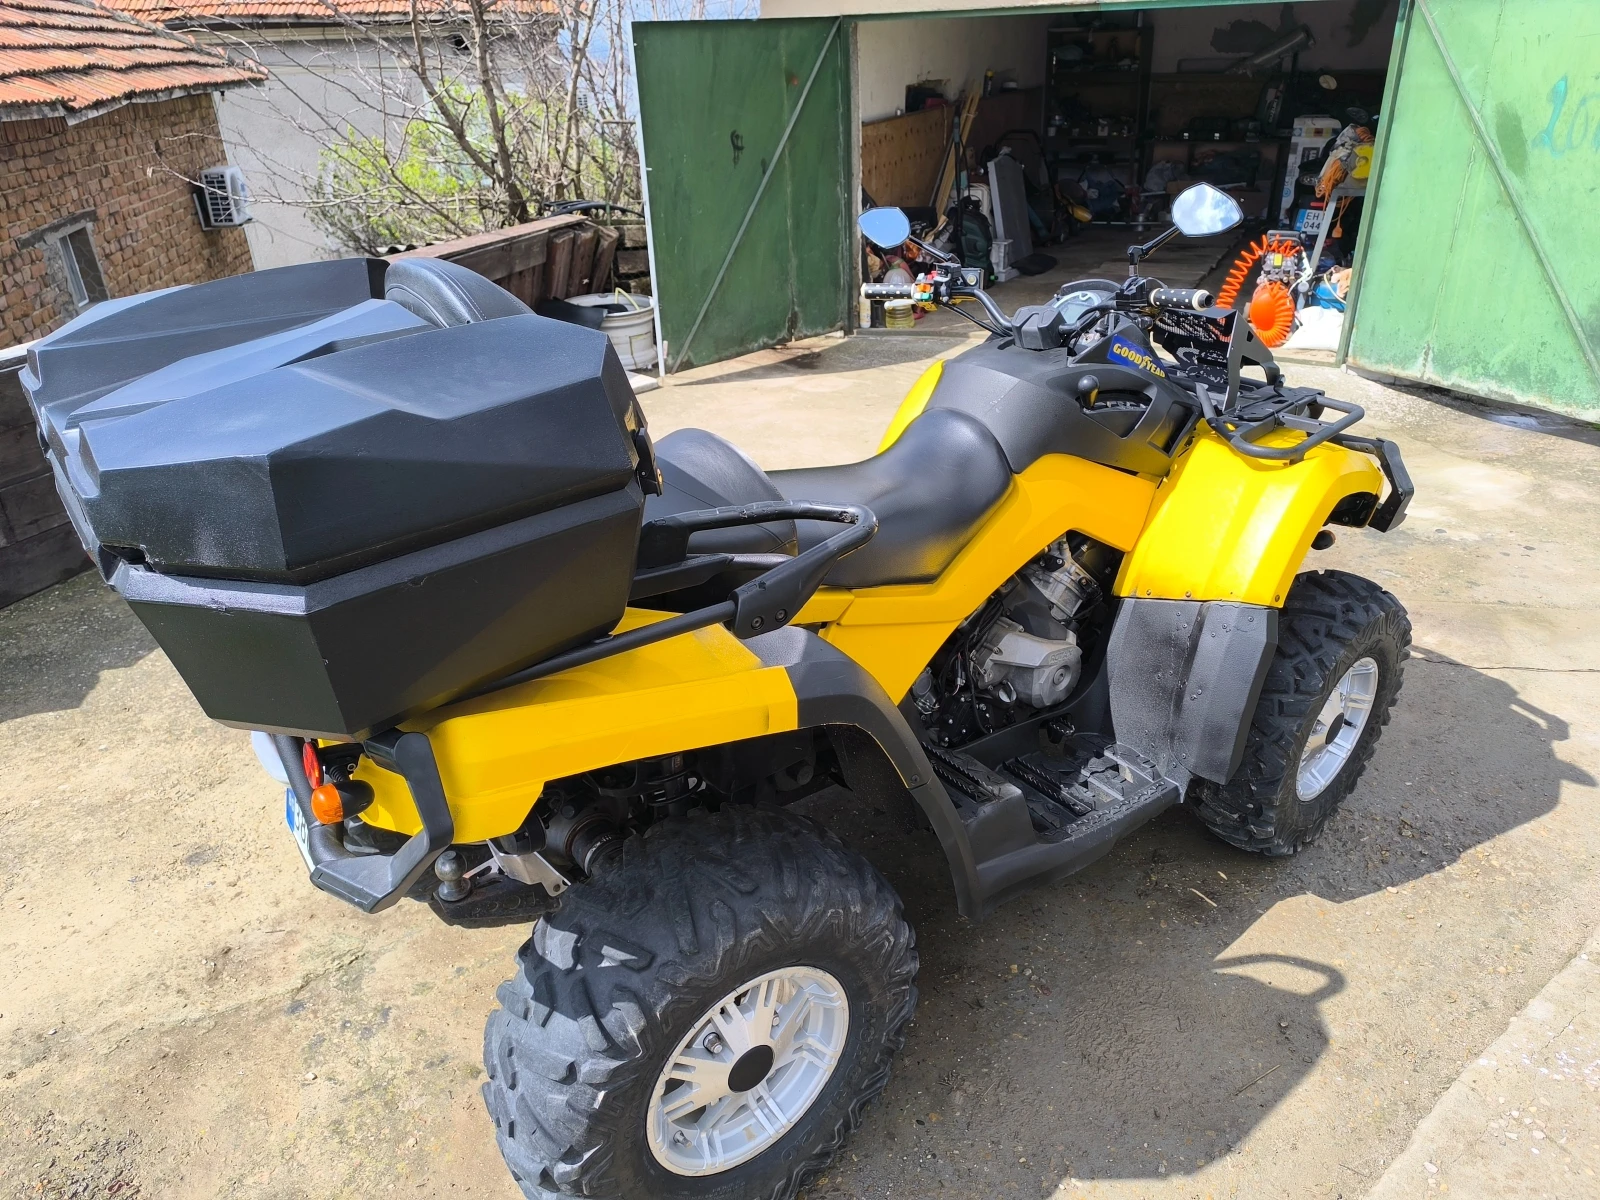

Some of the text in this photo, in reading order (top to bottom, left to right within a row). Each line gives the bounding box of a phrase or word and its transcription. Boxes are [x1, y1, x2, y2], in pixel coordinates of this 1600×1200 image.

[1306, 211, 1320, 221] EH
[1303, 221, 1321, 230] 044
[1113, 343, 1166, 378] GOODYEAR
